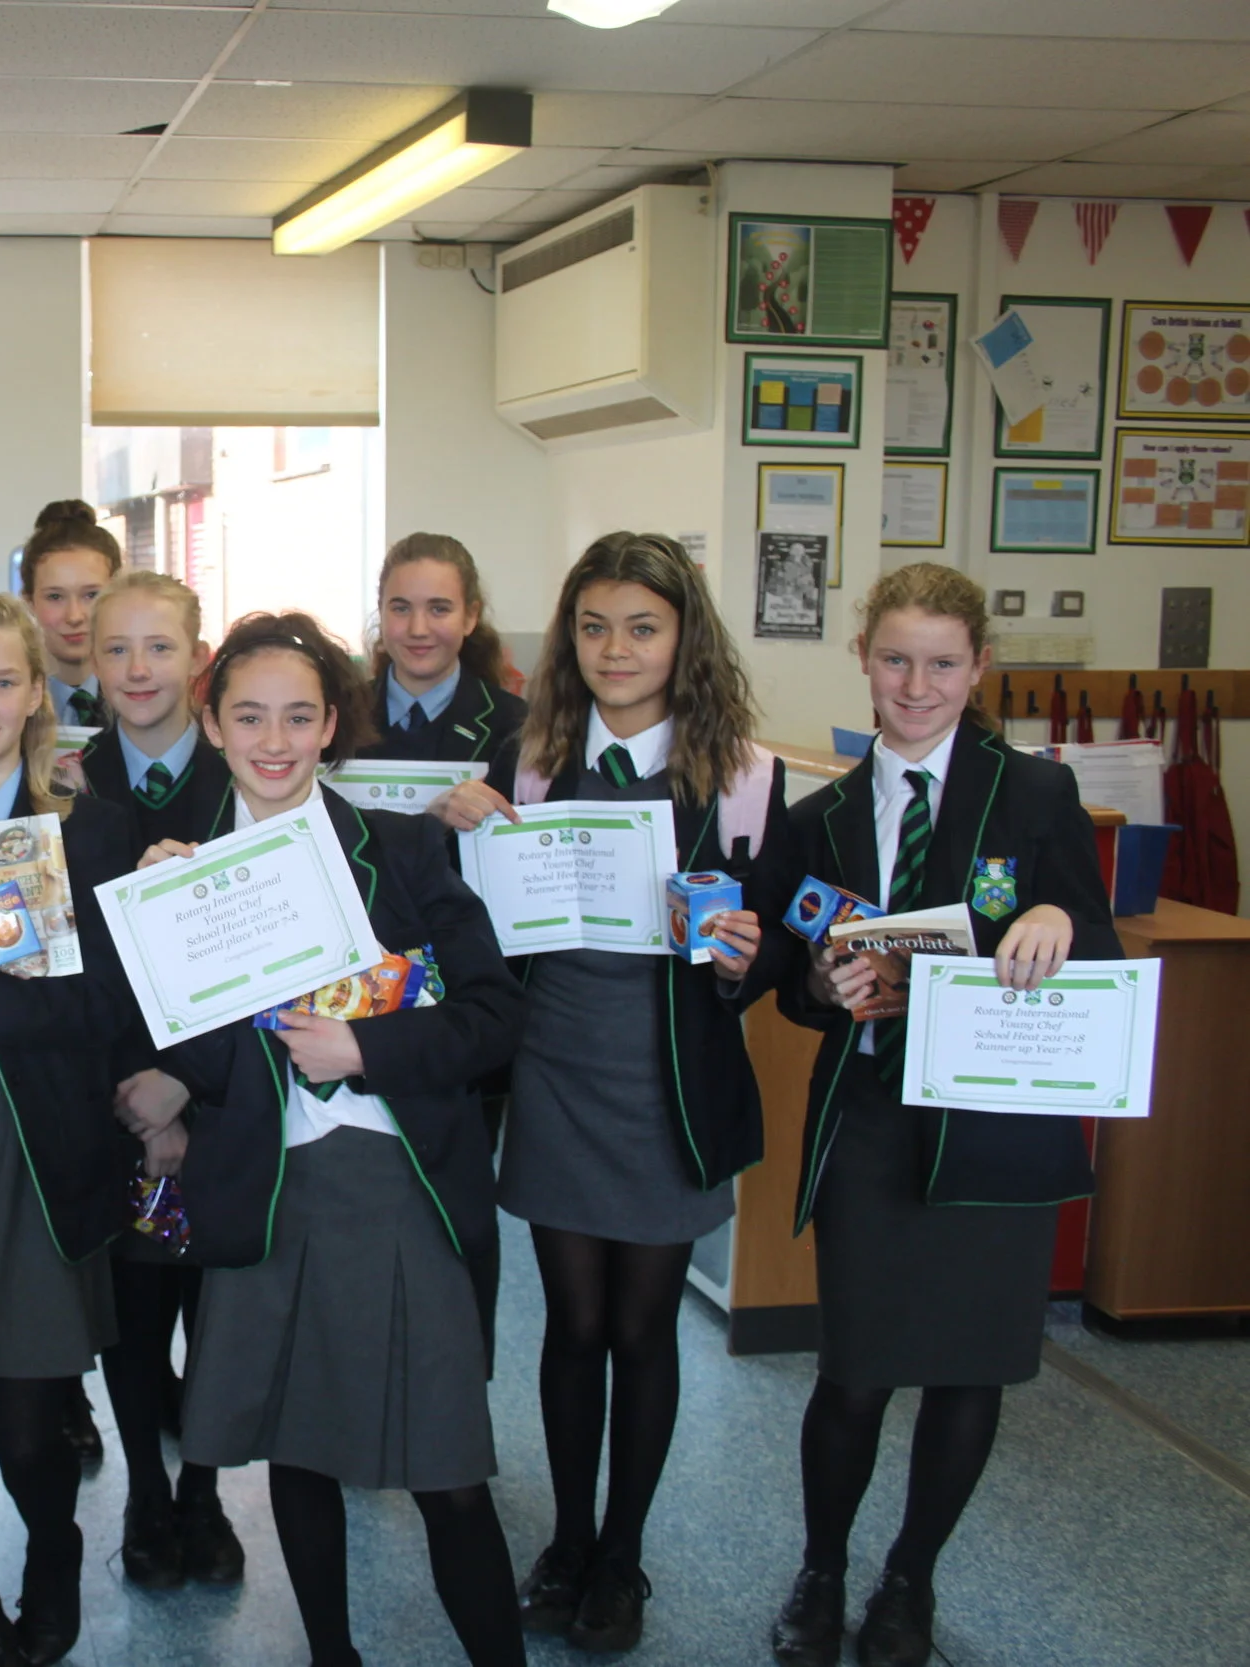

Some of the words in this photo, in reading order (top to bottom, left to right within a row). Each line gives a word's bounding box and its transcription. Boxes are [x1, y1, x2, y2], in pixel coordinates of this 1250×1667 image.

[518, 851, 552, 861] Rotary
[554, 848, 615, 859] International
[543, 861, 573, 871] Young
[575, 858, 595, 869] Chef
[522, 873, 554, 884] School
[556, 872, 580, 880] Heat
[525, 885, 562, 896] Runner
[564, 885, 577, 893] up
[579, 882, 599, 892] Year
[174, 902, 212, 924] Rotary
[213, 873, 282, 908] International
[203, 906, 238, 926] Young
[239, 895, 263, 915] Chef
[186, 926, 221, 948] School
[222, 918, 248, 936] Heat
[249, 900, 290, 926] 2017-18
[187, 939, 225, 963] Second
[226, 930, 252, 950] place
[254, 918, 280, 937] Year
[281, 912, 299, 929] 7-8
[847, 935, 957, 953] Chocolate
[53, 948, 75, 958] 100
[974, 1006, 1013, 1018] Rotary
[1015, 1007, 1090, 1019] International
[999, 1019, 1034, 1031] Young
[1037, 1021, 1065, 1031] Chef
[974, 1030, 1010, 1041] School
[1012, 1032, 1040, 1042] Heat
[1042, 1034, 1085, 1043] 2017-18
[975, 1042, 1016, 1052] Runner
[1018, 1045, 1034, 1054] up
[1035, 1044, 1062, 1054] Year
[1064, 1046, 1083, 1056] 7-8
